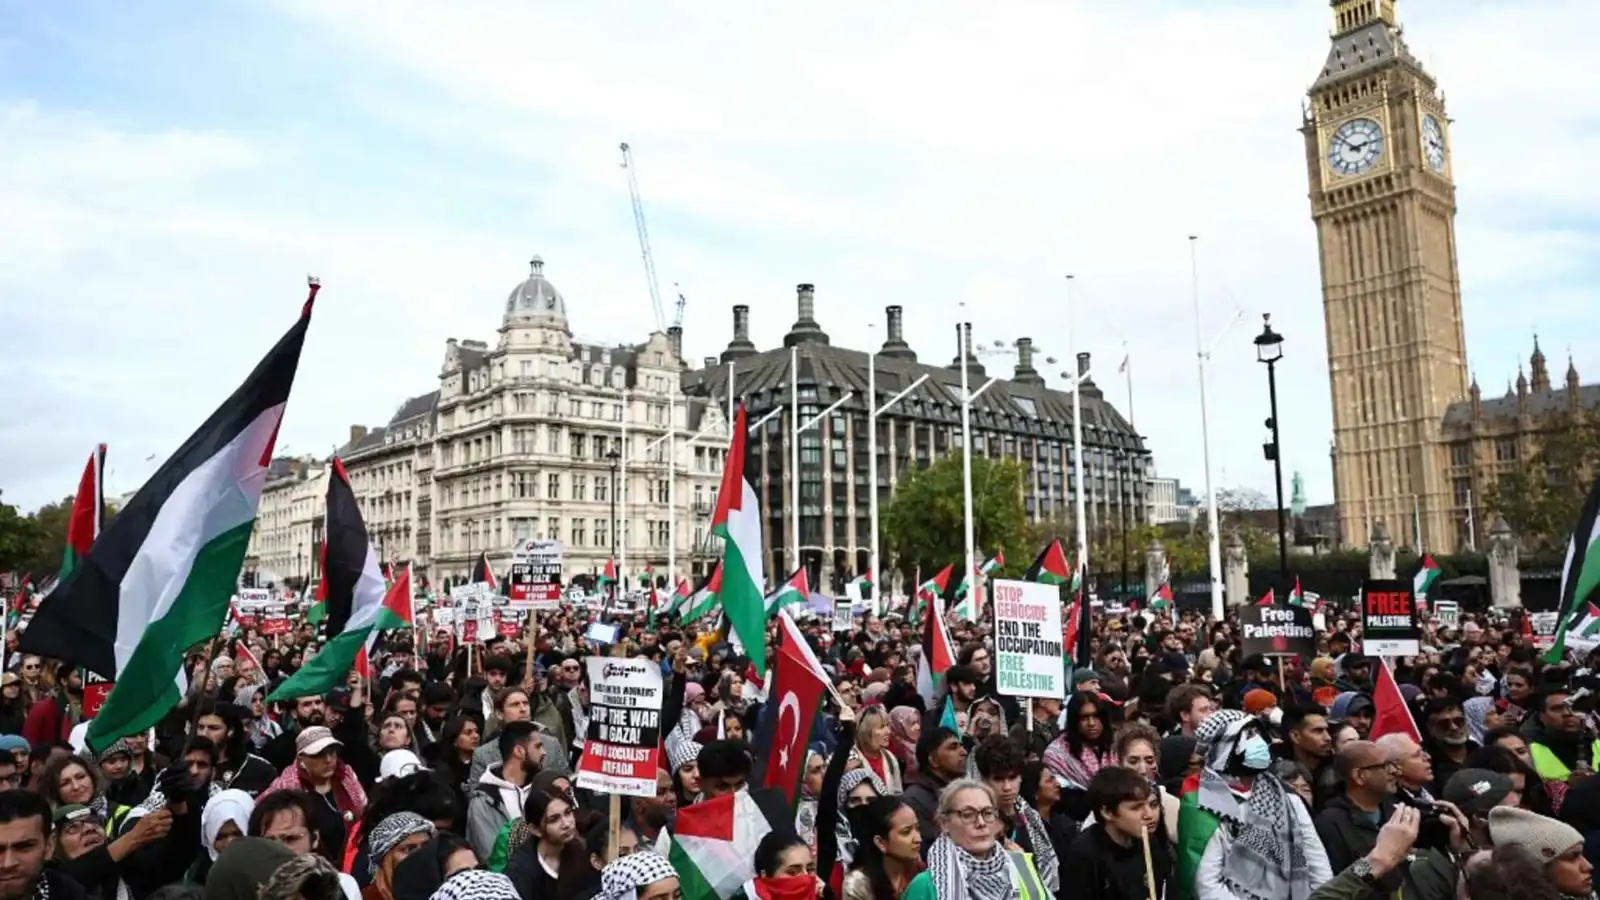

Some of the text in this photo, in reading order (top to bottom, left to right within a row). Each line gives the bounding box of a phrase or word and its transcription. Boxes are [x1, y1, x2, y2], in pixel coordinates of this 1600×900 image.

[996, 586, 1023, 602] STOP
[997, 603, 1047, 621] GENOCIDE
[1367, 592, 1410, 615] FREE
[1260, 607, 1295, 622] Free
[1367, 615, 1412, 627] PALESTINE
[998, 620, 1042, 638] END THE
[1243, 623, 1314, 639] Palestine
[998, 637, 1062, 657] OCCUPATION
[999, 655, 1025, 672] FREE
[999, 671, 1054, 691] PALESTINE
[630, 710, 659, 728] WAR
[609, 726, 641, 744] GAZA!
